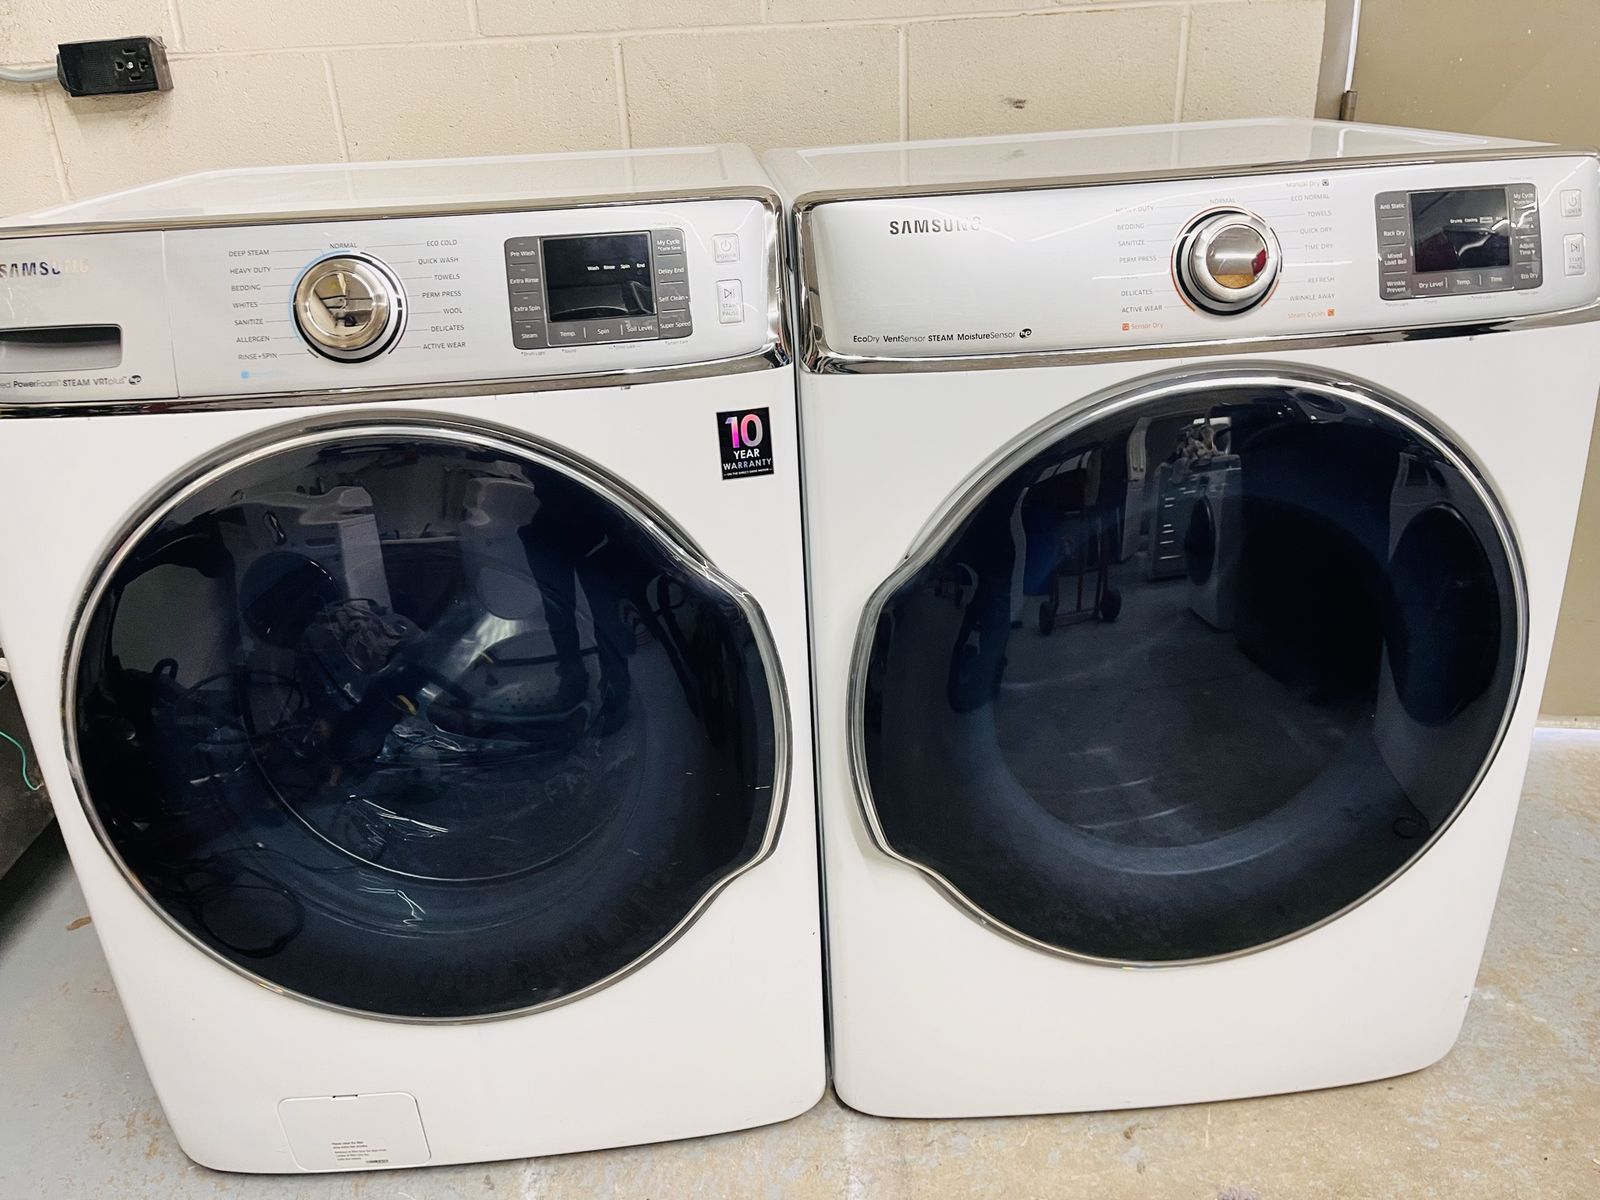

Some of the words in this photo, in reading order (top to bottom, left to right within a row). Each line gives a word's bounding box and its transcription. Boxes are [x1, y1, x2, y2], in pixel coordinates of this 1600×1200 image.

[889, 216, 982, 235] SAMSUNG
[1117, 223, 1145, 231] BEDDING
[418, 258, 438, 266] QUICK
[1121, 289, 1153, 297] DELICATES
[431, 324, 465, 332] DELICATES
[638, 324, 653, 332] Level
[1152, 322, 1164, 330] Dry
[597, 328, 610, 336] Spin
[853, 335, 880, 343] EcoDry
[883, 335, 926, 343] VentSensor
[928, 334, 954, 342] STEAM
[957, 331, 1016, 341] MoistureSensor
[63, 379, 91, 387] STEAM
[725, 414, 763, 448] 10
[733, 449, 760, 459] YEAR
[723, 458, 772, 470] WARRANTY
